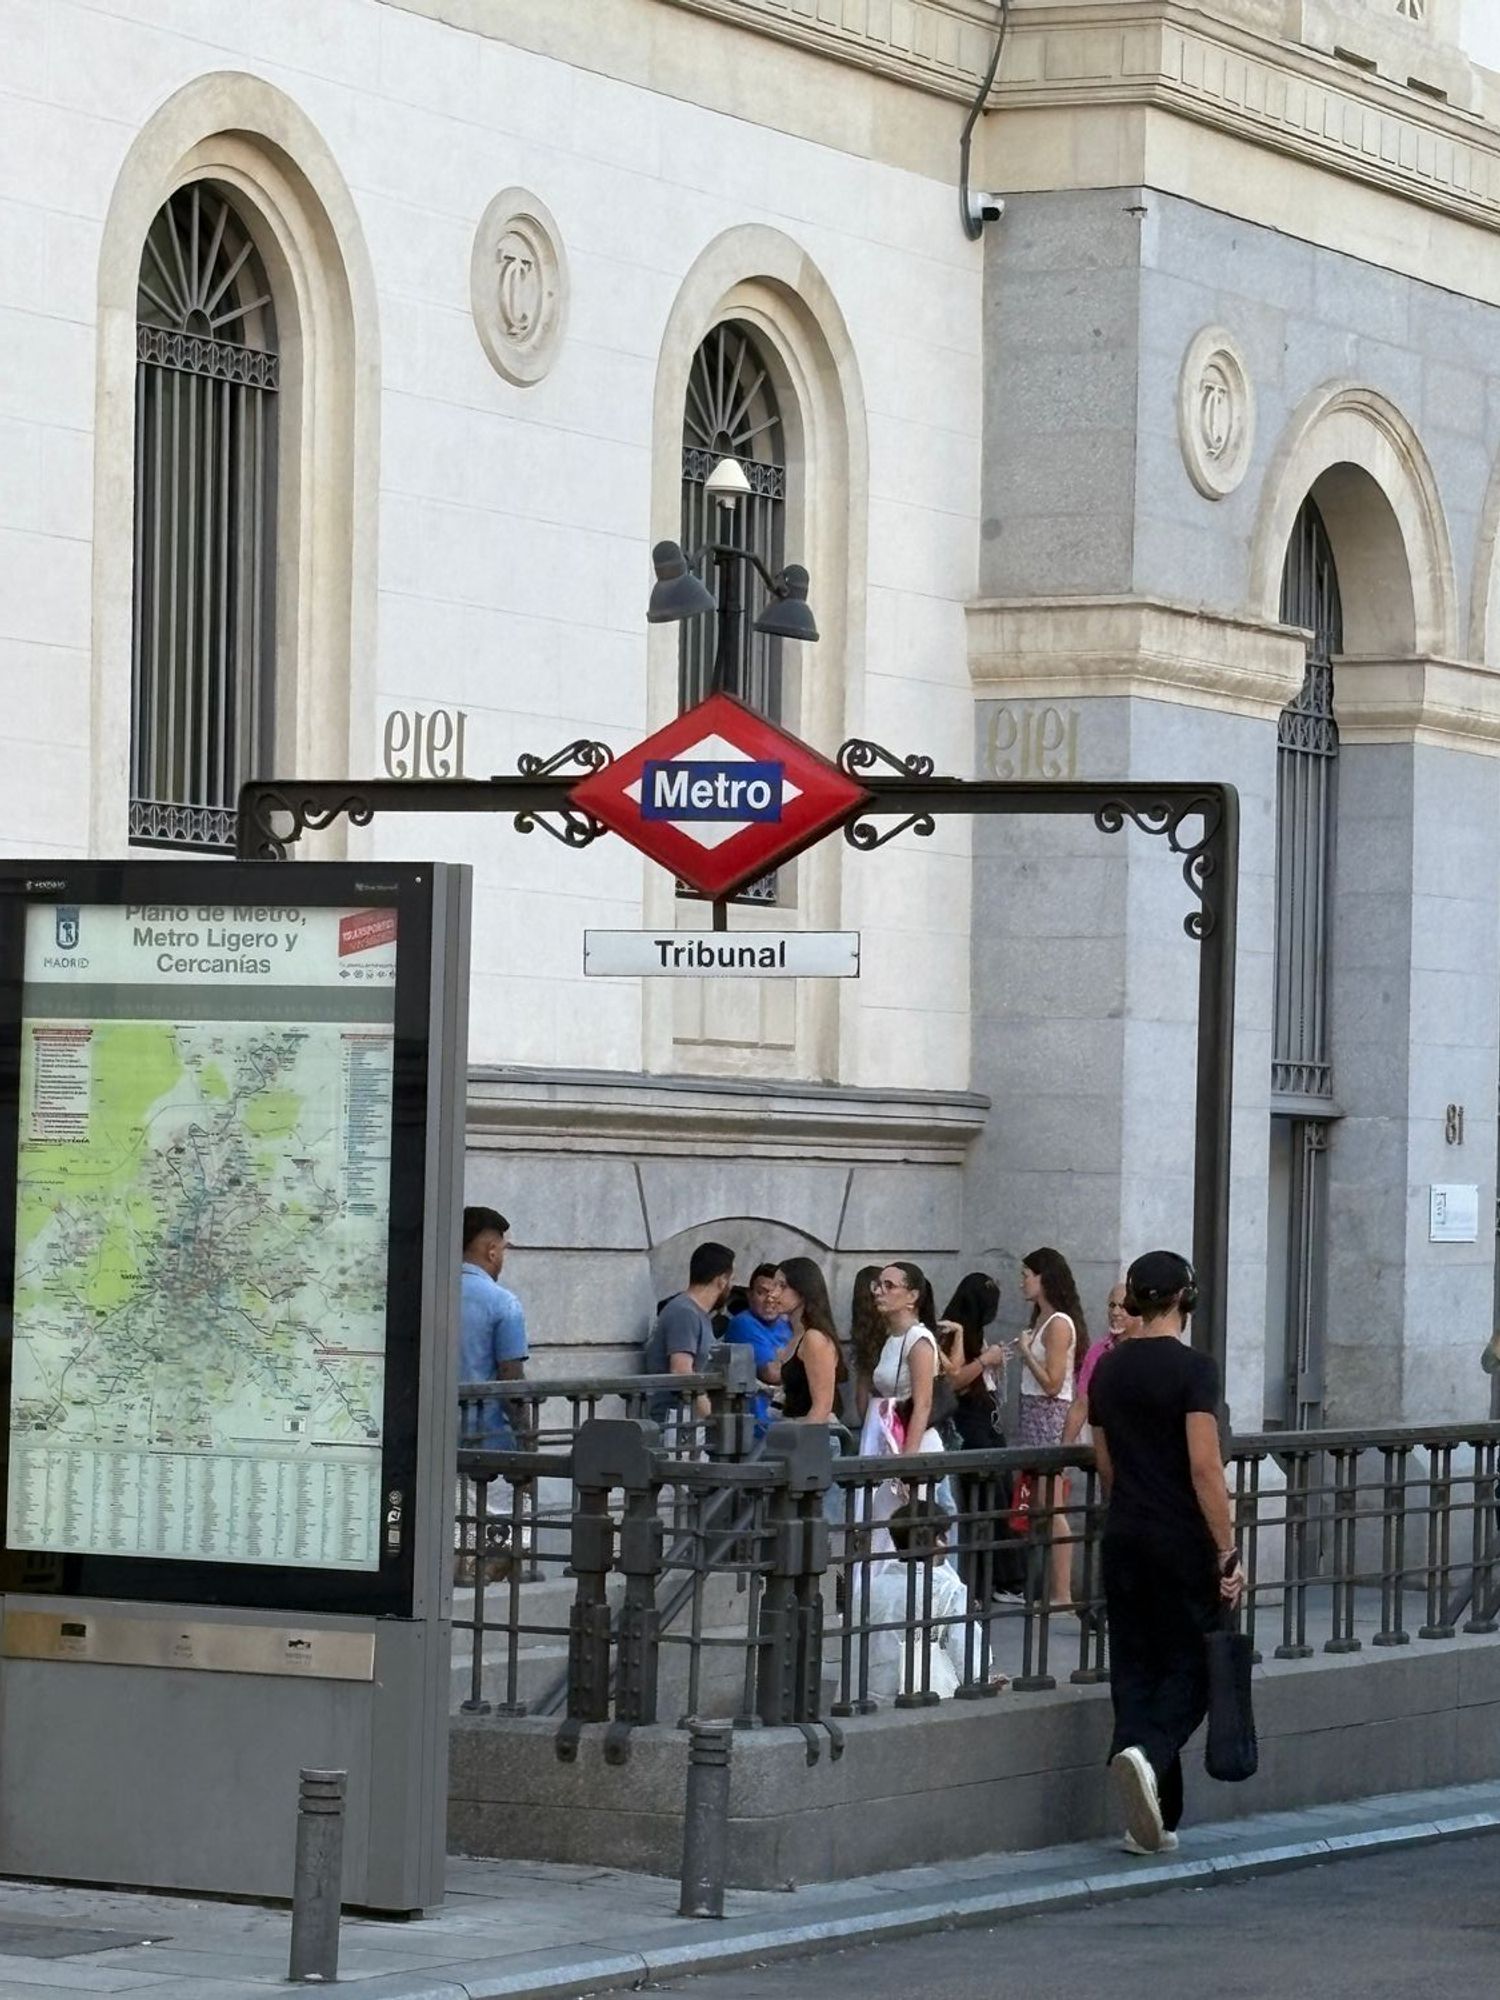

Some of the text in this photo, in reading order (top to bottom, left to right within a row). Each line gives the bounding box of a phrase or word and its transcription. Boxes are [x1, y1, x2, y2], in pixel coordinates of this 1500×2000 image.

[654, 770, 772, 810] Metro
[125, 905, 307, 926] Plano de Metro,
[133, 927, 299, 952] Metro Ligero y
[43, 957, 90, 969] MADRID
[156, 953, 272, 974] Cercanías
[654, 940, 786, 968] Tribunal
